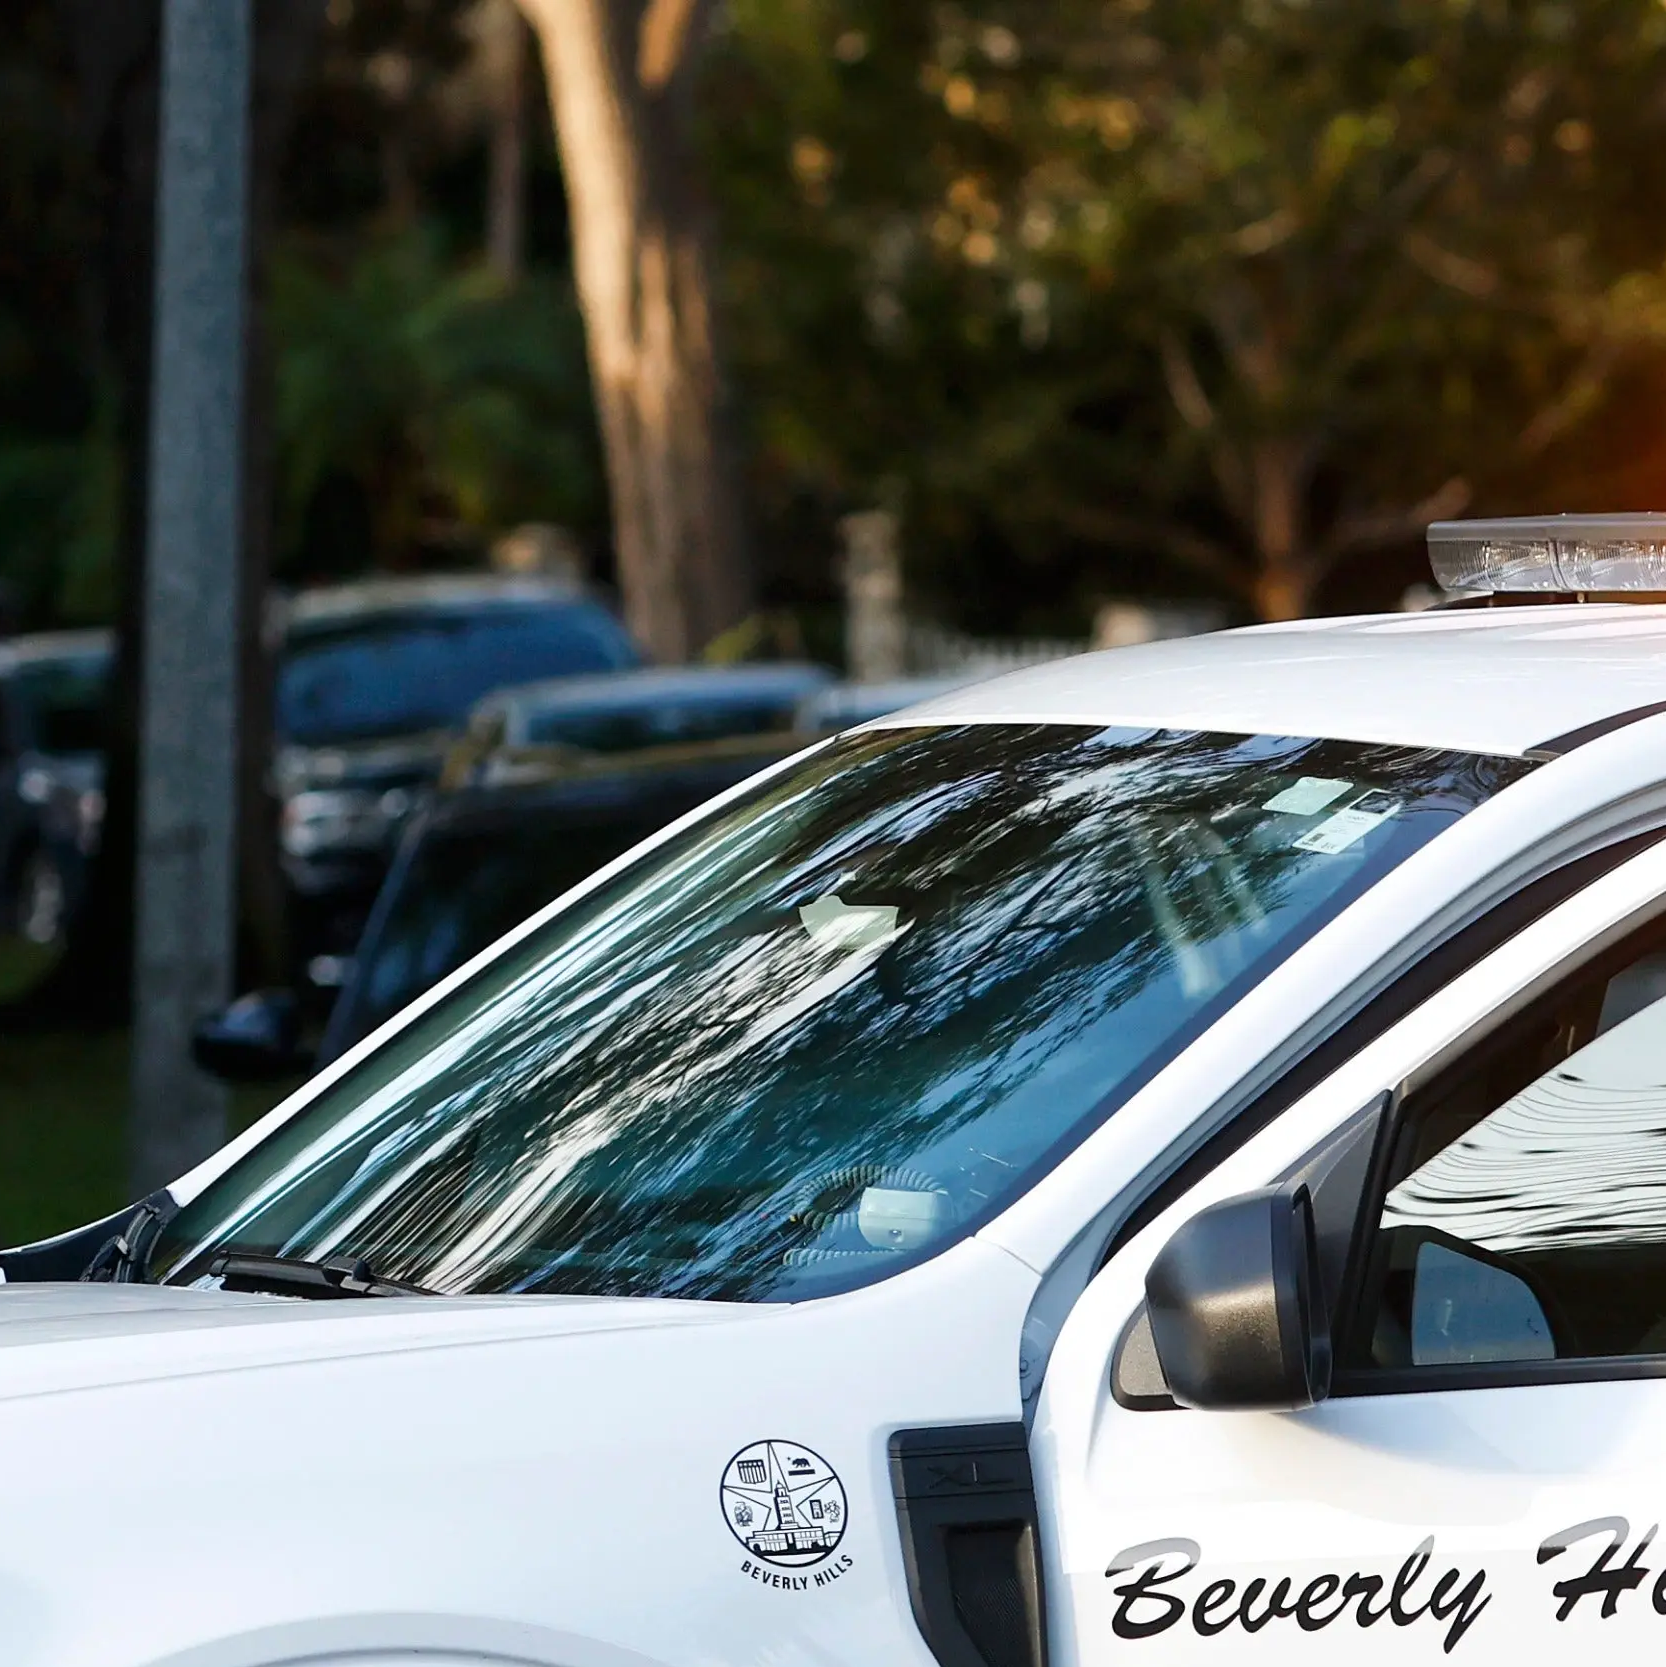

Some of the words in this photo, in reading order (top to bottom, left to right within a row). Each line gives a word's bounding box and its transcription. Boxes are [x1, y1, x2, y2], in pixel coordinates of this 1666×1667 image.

[740, 1559, 809, 1591] BEVERLY
[813, 1553, 854, 1588] HILLS
[1105, 1533, 1492, 1655] Beverly
